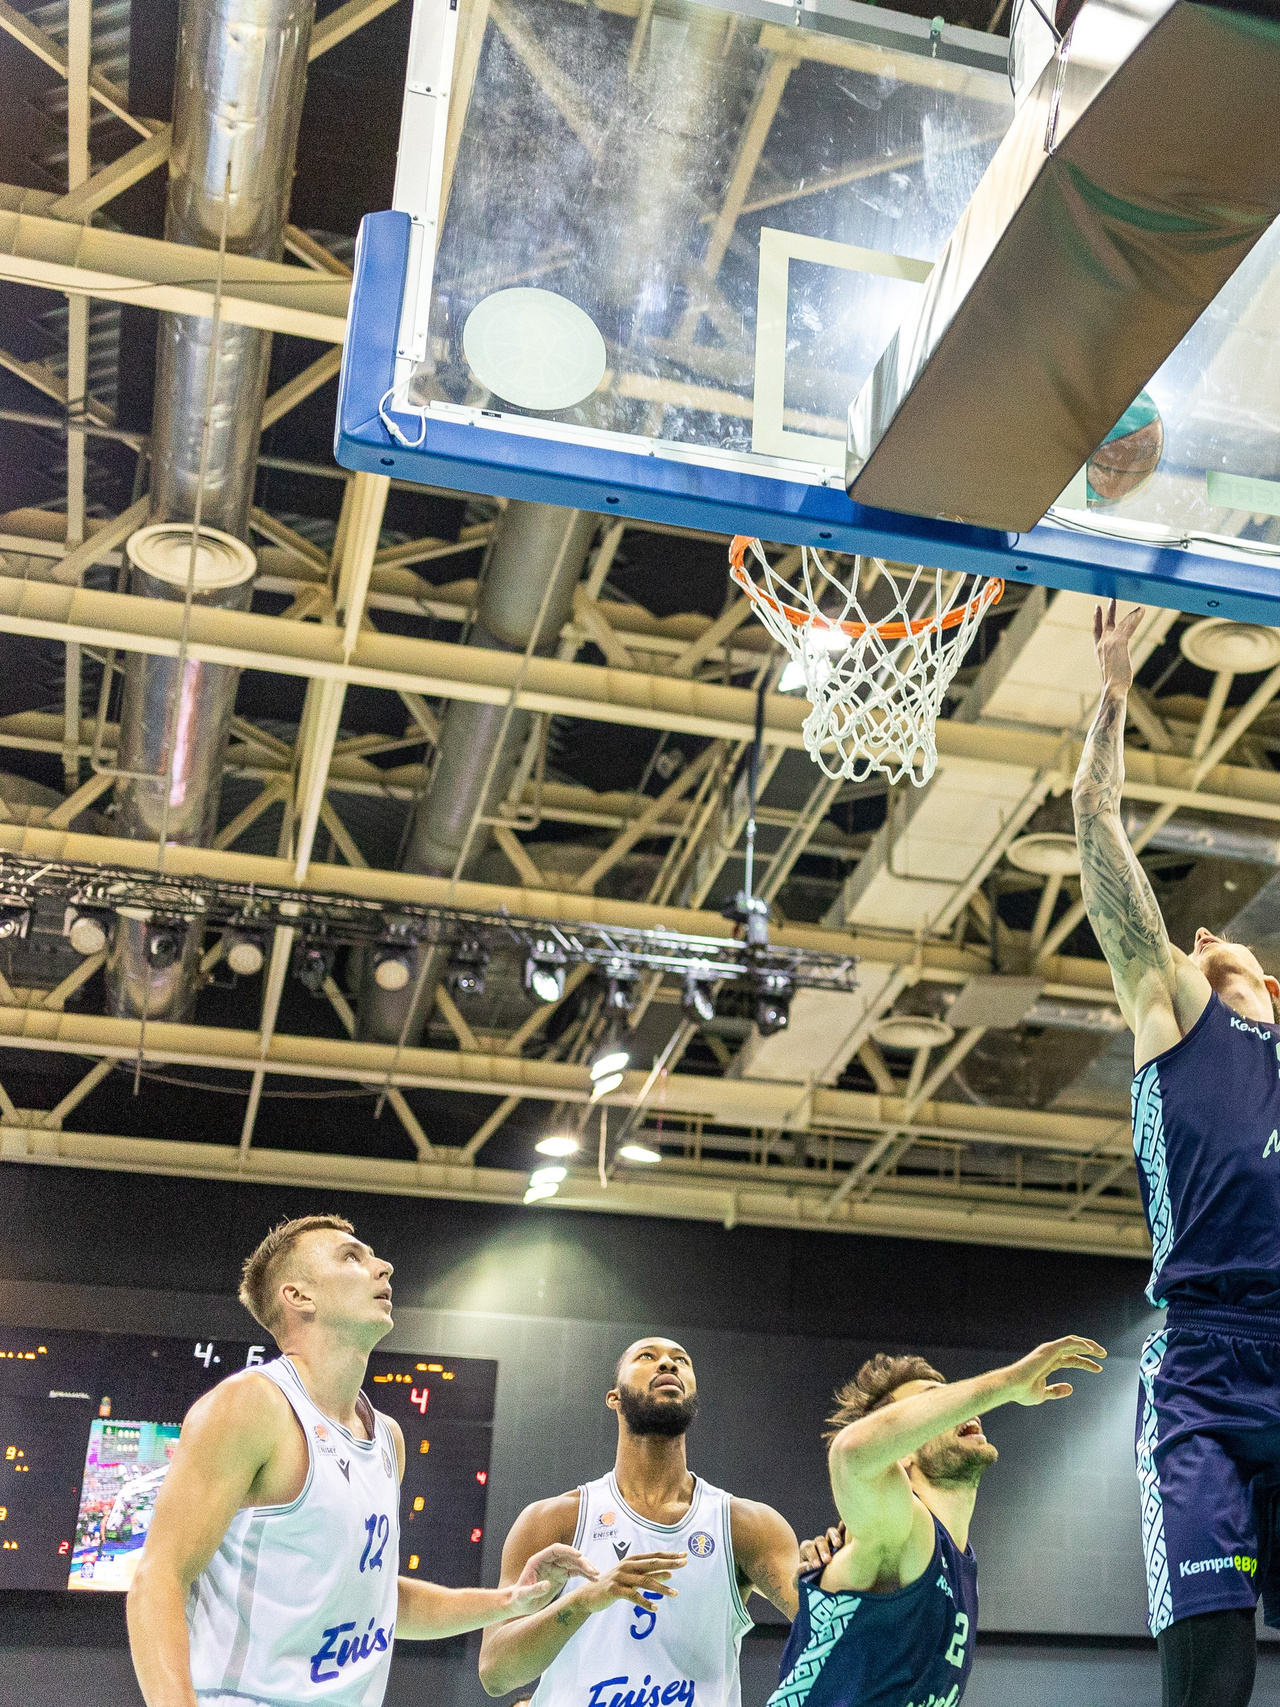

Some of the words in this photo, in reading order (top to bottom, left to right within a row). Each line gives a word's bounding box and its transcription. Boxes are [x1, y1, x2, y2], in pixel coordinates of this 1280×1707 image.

[410, 1387, 430, 1415] 4
[58, 1540, 70, 1555] 2
[359, 1513, 390, 1573] 12
[310, 1616, 395, 1683] Enis
